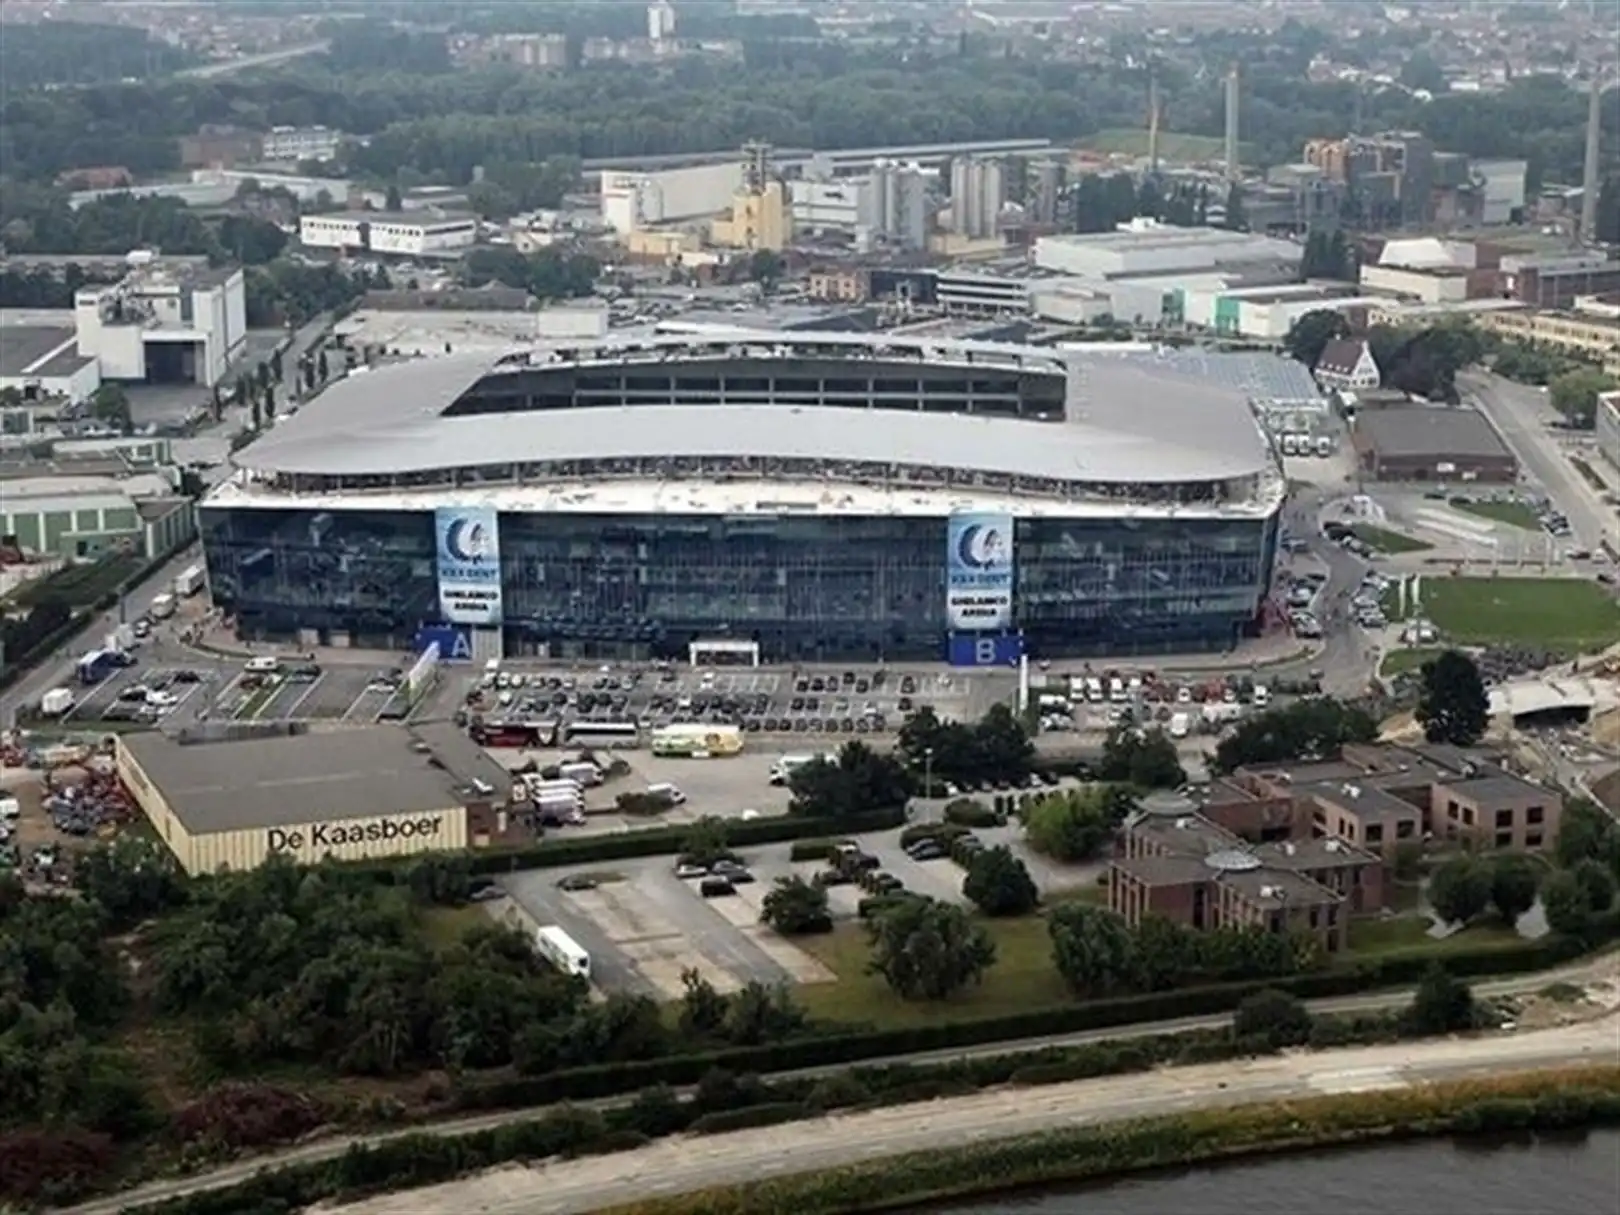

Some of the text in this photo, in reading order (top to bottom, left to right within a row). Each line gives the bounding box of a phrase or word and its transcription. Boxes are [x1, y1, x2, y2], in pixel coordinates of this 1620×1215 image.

[451, 632, 471, 657] A
[976, 638, 996, 663] B
[267, 816, 442, 851] De Kaasboer
